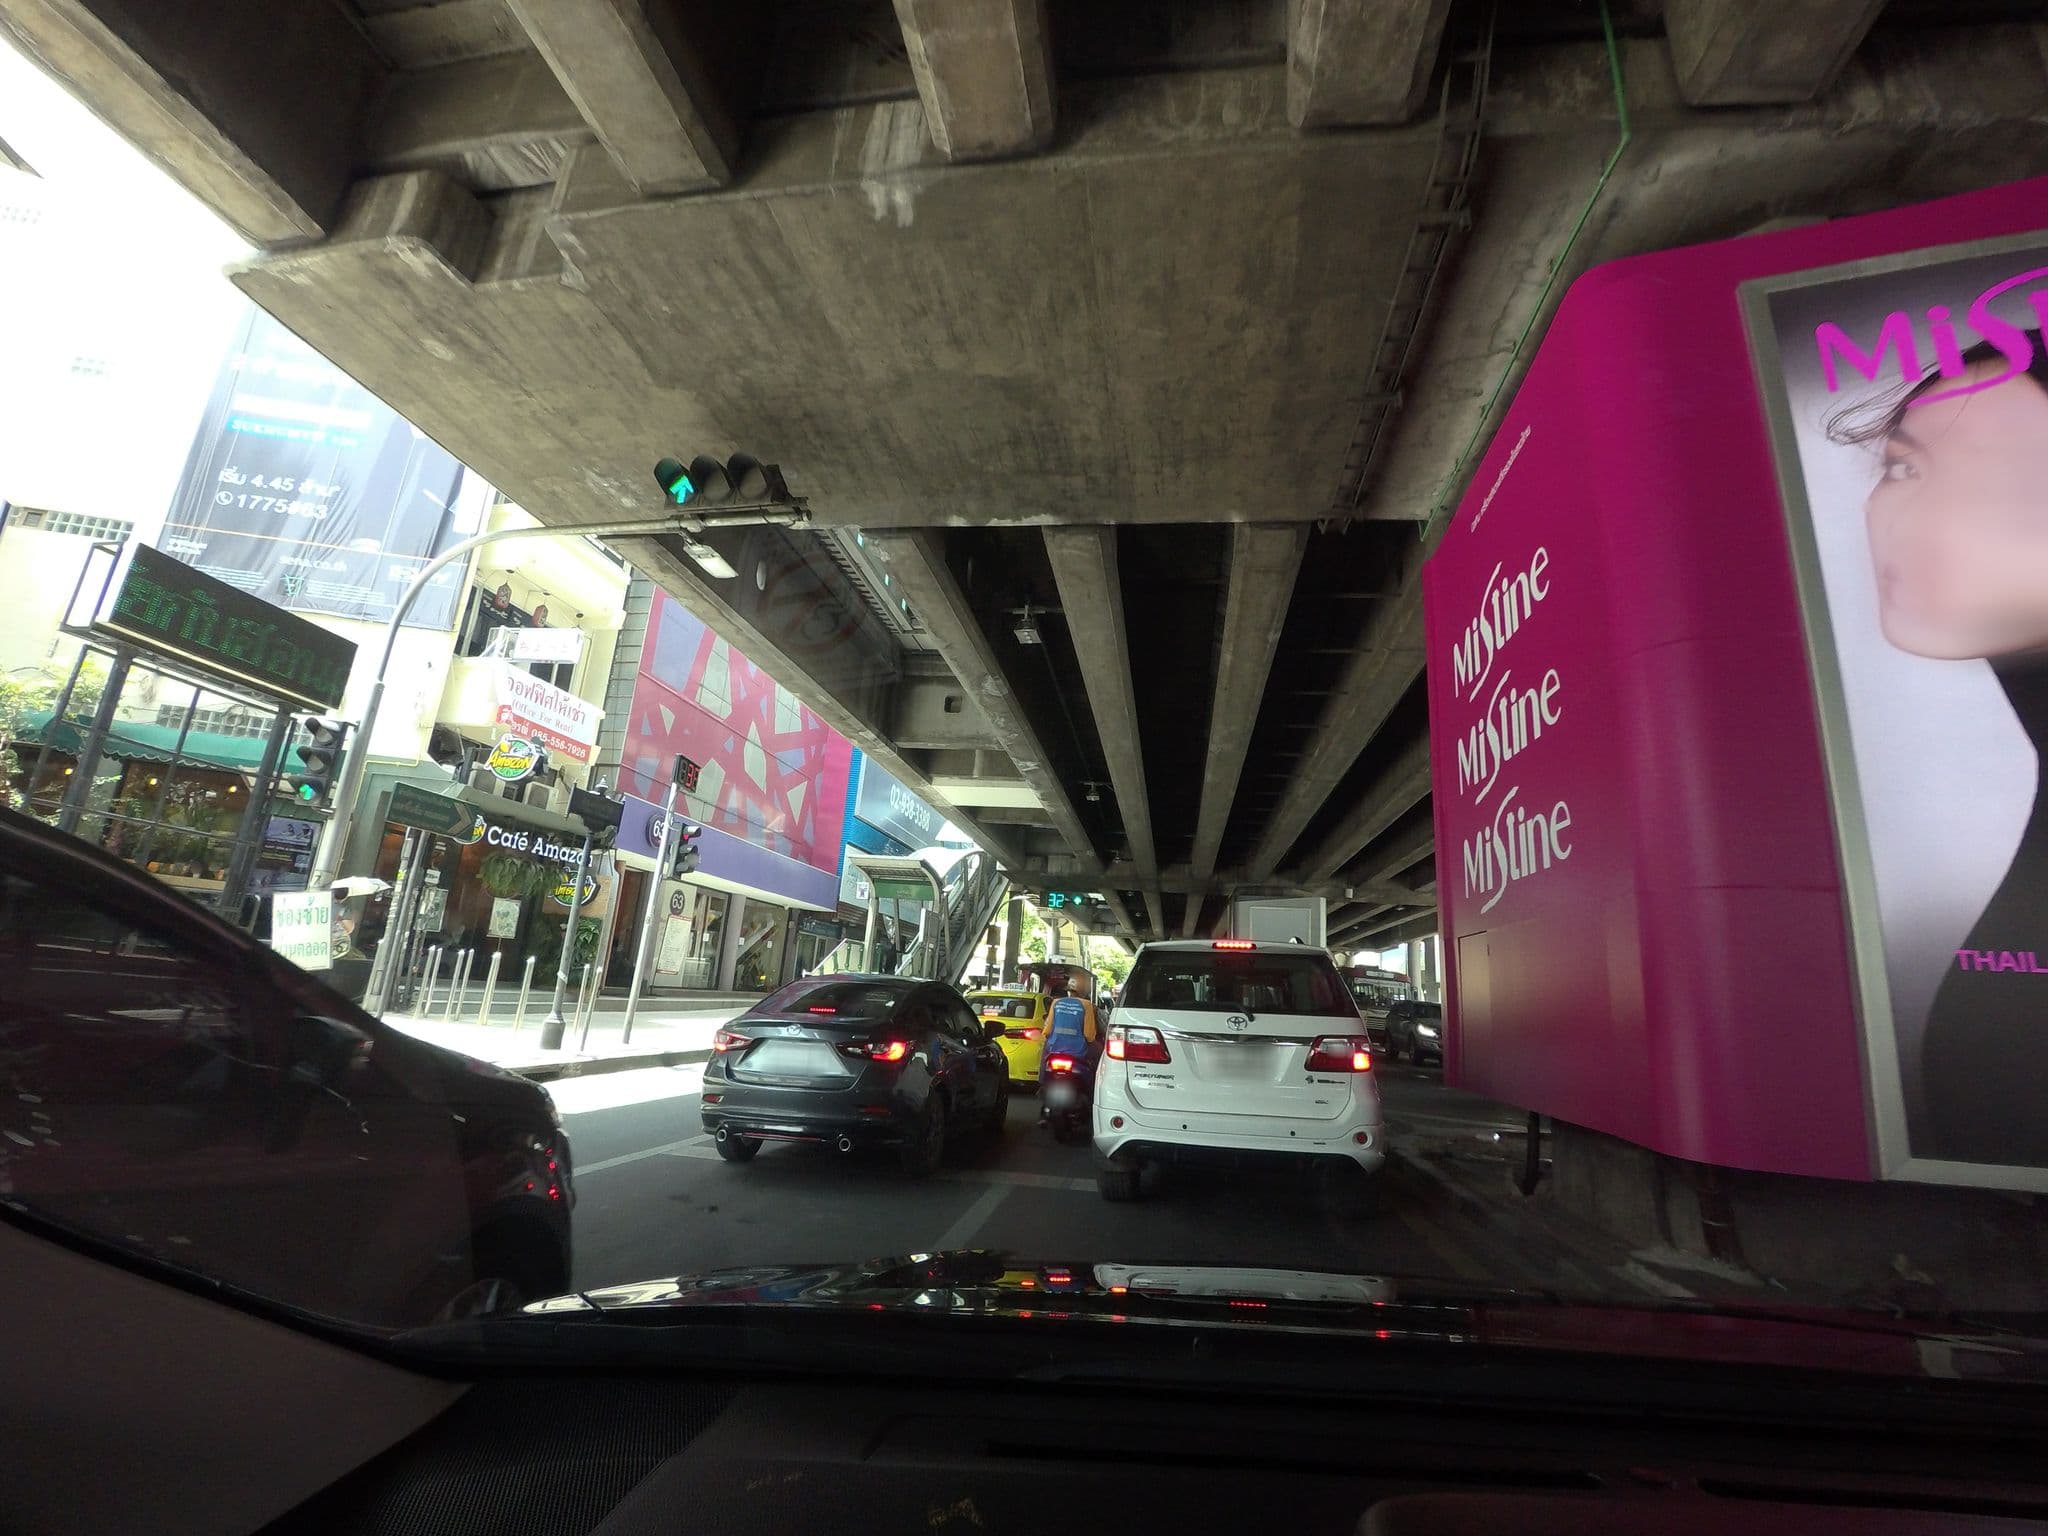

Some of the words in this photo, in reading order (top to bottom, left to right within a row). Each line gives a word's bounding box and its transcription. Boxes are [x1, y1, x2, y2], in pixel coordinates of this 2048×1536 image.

[487, 826, 529, 851] Café
[672, 893, 683, 910] 63
[1048, 893, 1065, 908] 32
